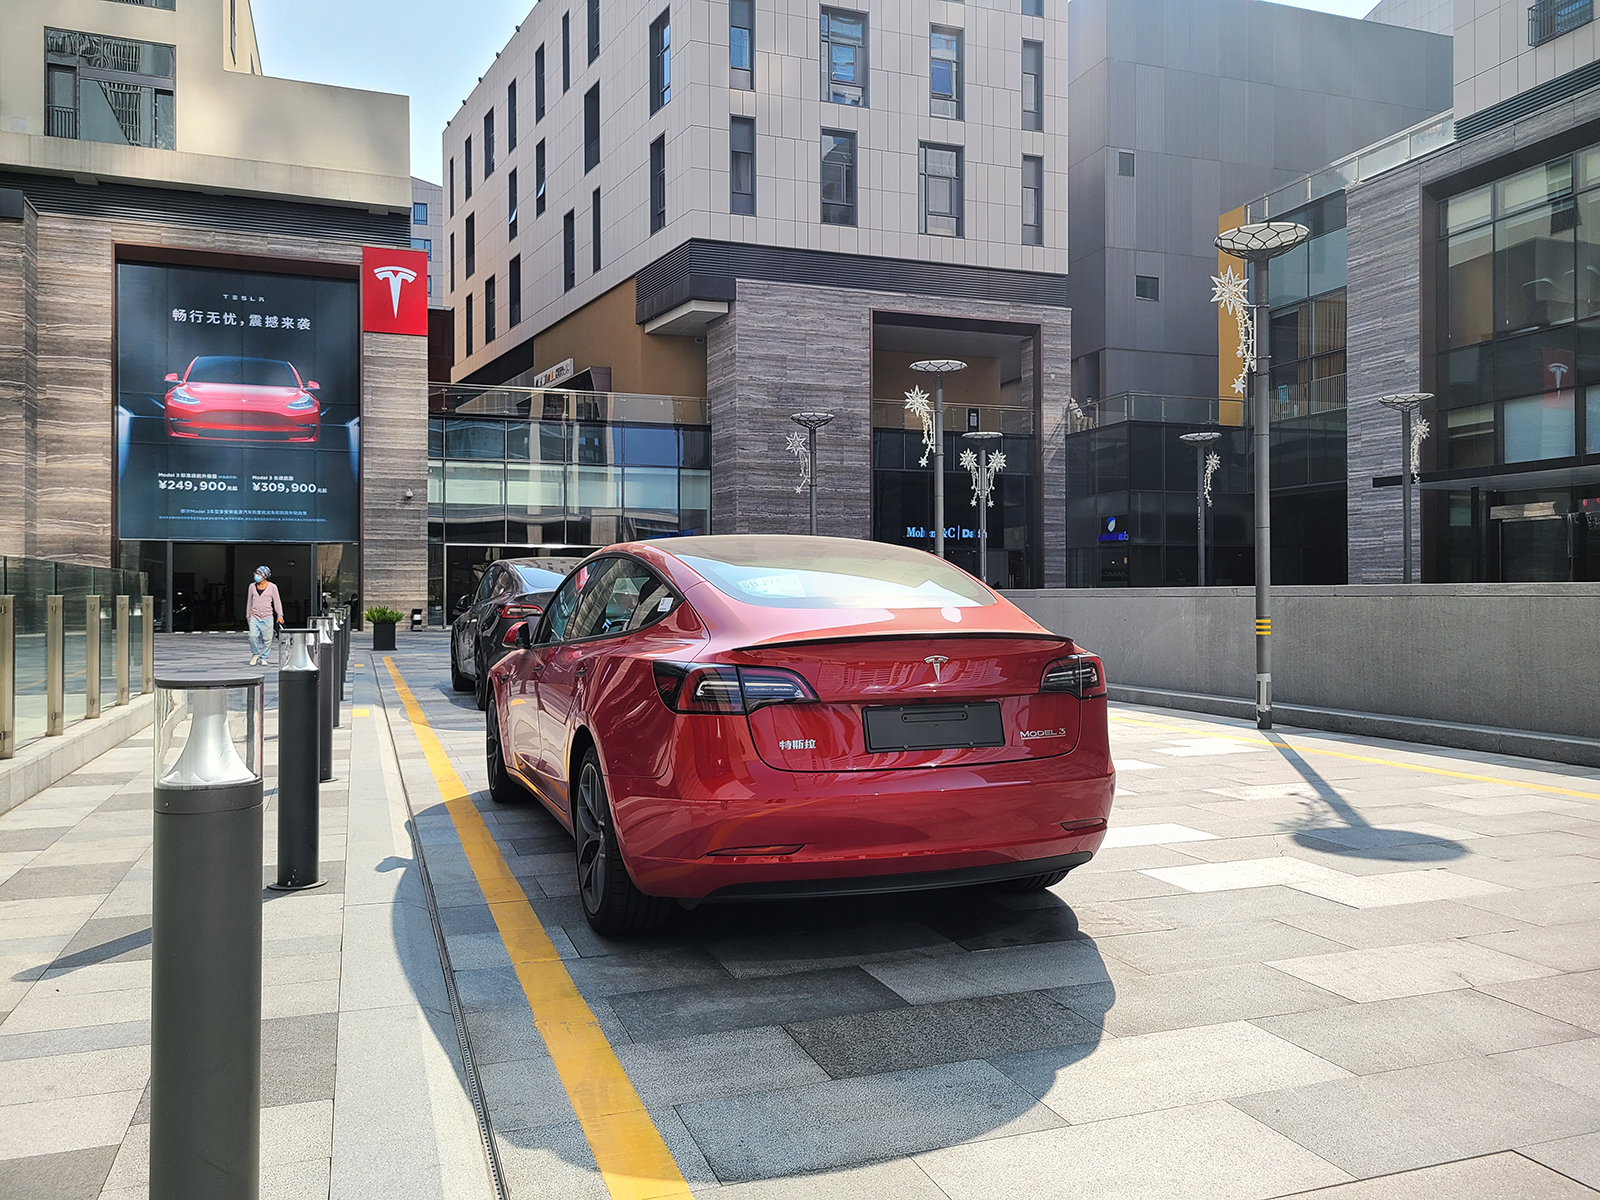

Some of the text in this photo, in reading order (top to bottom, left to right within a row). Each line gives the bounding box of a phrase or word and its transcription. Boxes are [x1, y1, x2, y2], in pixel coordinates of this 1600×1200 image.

[223, 293, 265, 302] TESLA
[1020, 727, 1066, 738] MODEL 3
[779, 739, 817, 750] 特斯拉
